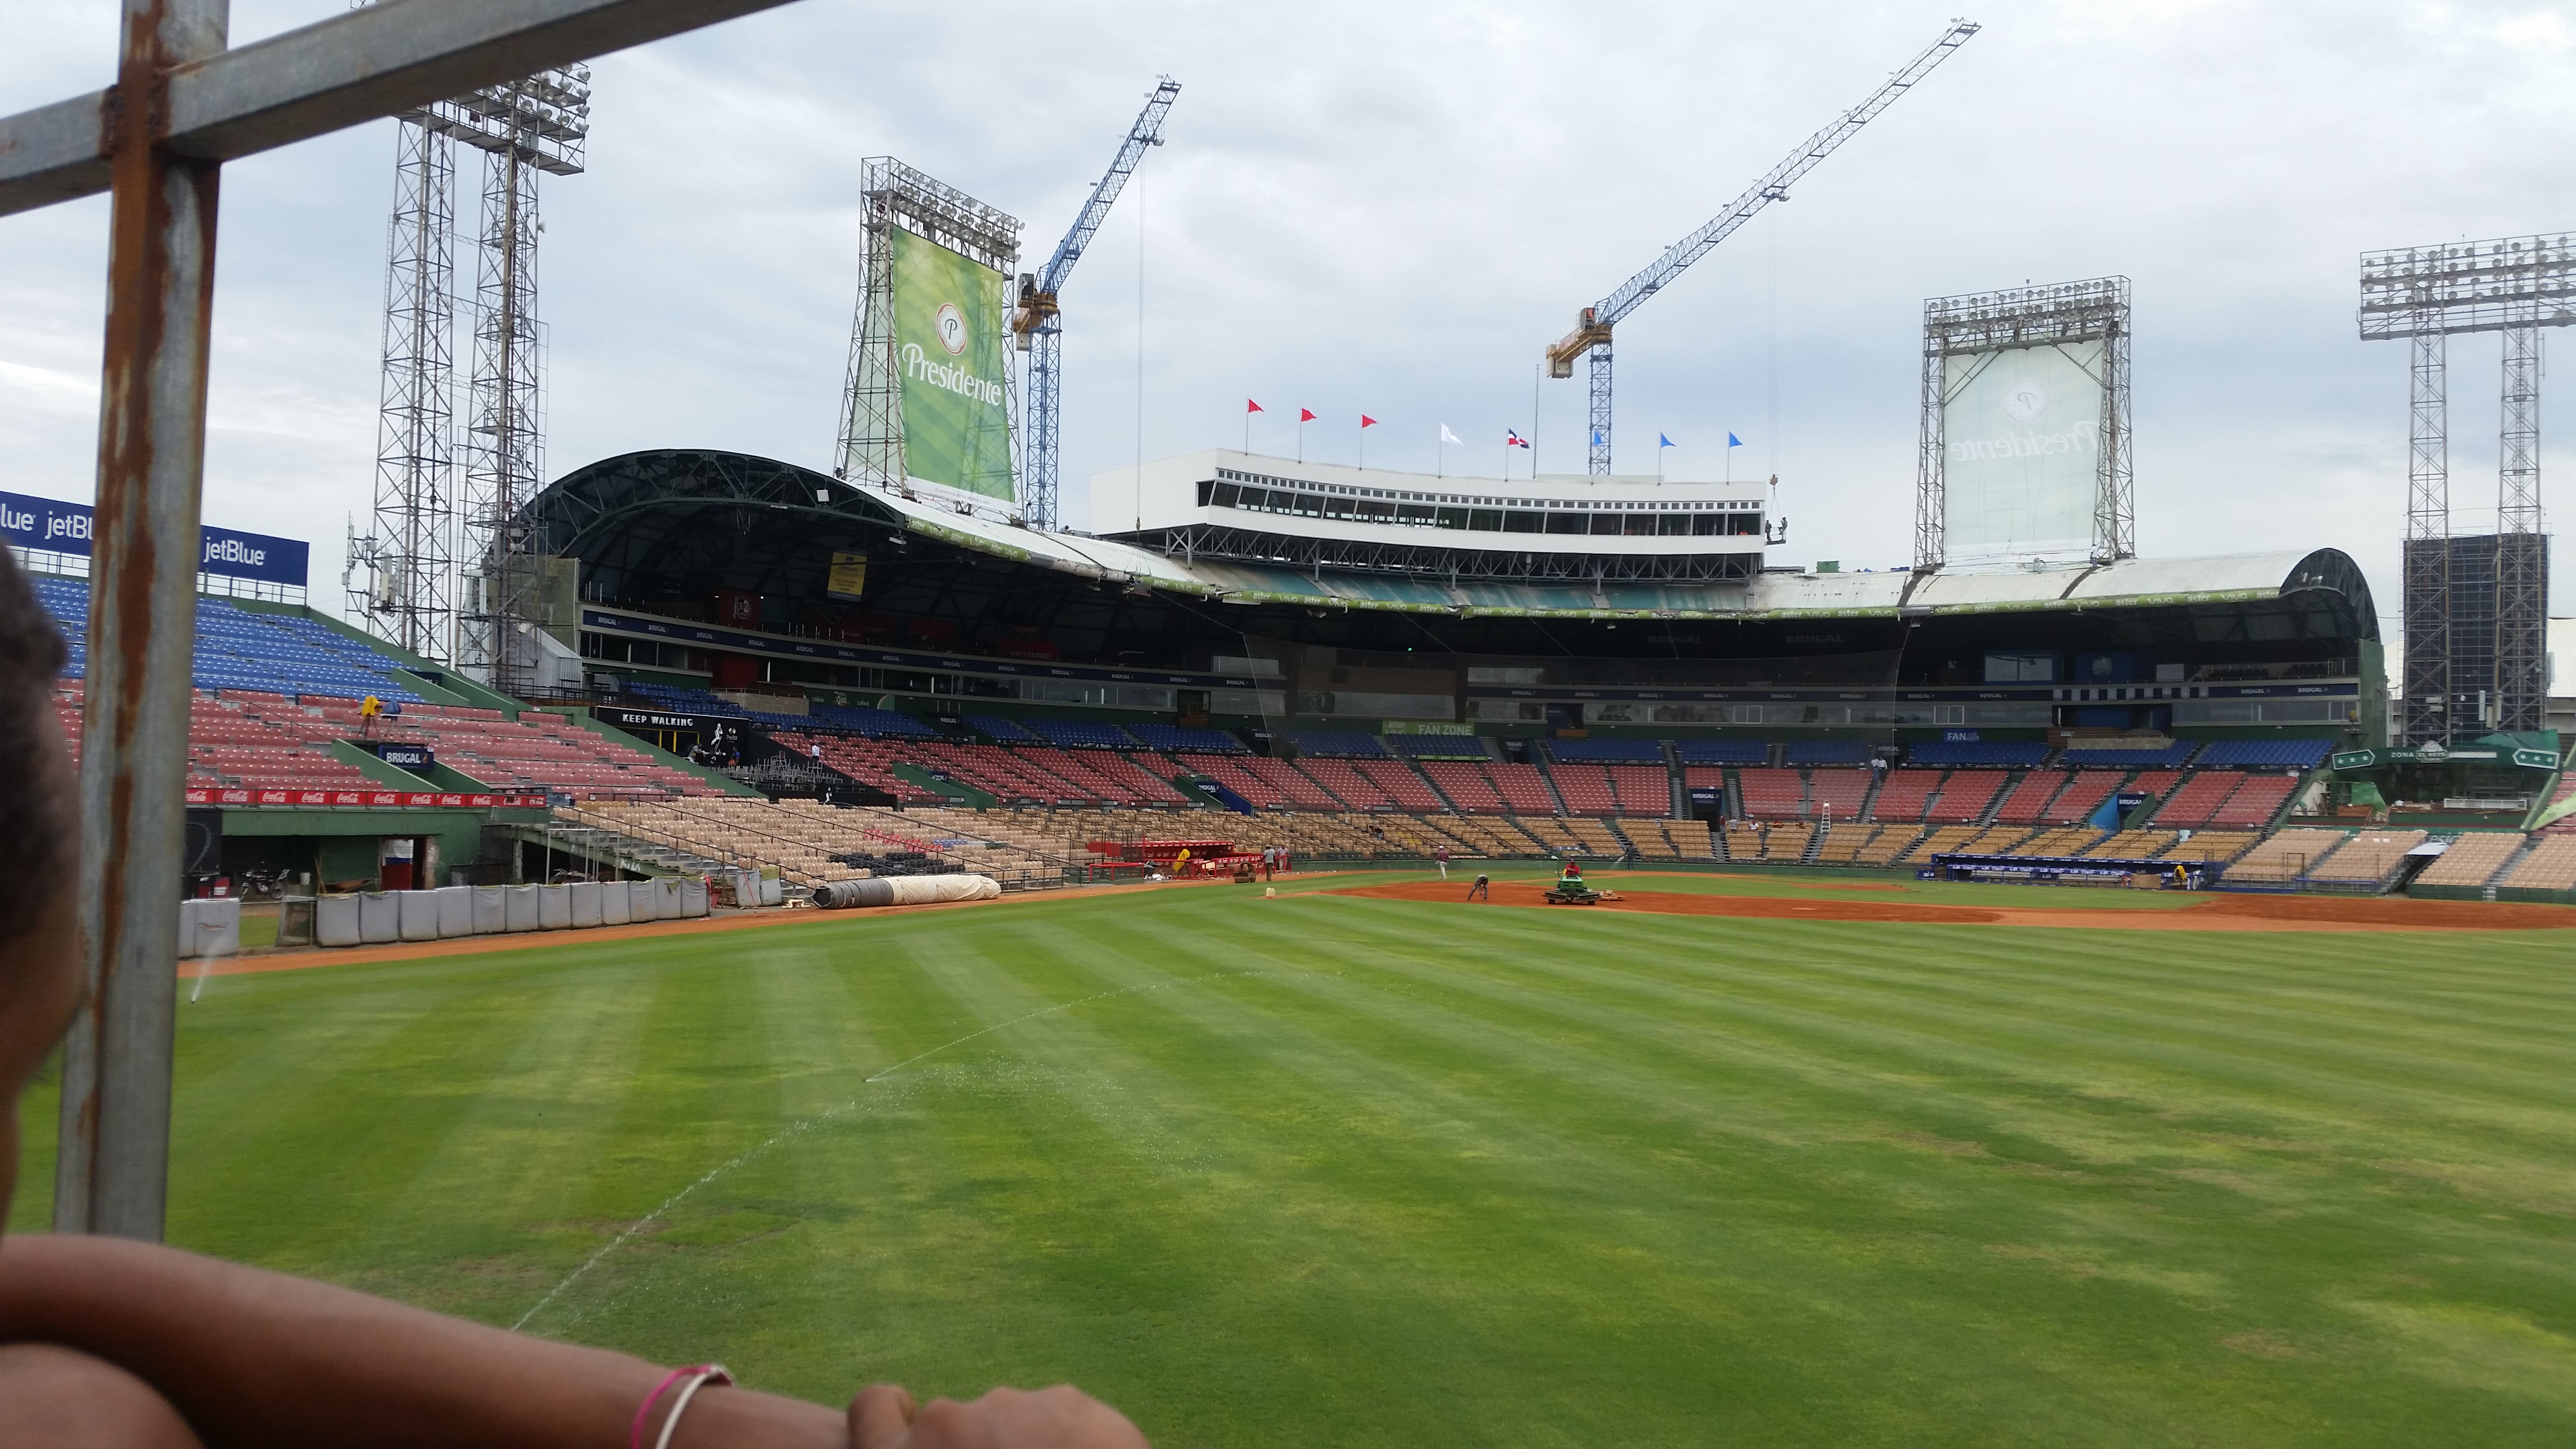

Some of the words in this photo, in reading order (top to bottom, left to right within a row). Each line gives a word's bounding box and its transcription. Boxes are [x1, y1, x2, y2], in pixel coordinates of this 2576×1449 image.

[902, 343, 1002, 406] Presidente
[45, 511, 93, 540] jetBl
[203, 536, 264, 566] jetBlue
[1153, 580, 1169, 588] aster
[1253, 592, 1271, 600] aster
[1419, 604, 1438, 612] aster
[2044, 600, 2066, 609] aster
[2115, 598, 2138, 606] aster
[2188, 593, 2210, 602] aster
[2257, 591, 2279, 599] aster
[598, 617, 617, 626] BRUGAL
[623, 714, 647, 723] KEEP
[651, 716, 693, 726] WALKING
[1418, 724, 1440, 735] FAN
[1442, 725, 1472, 736] ZONE
[386, 752, 421, 763] BRUGAL
